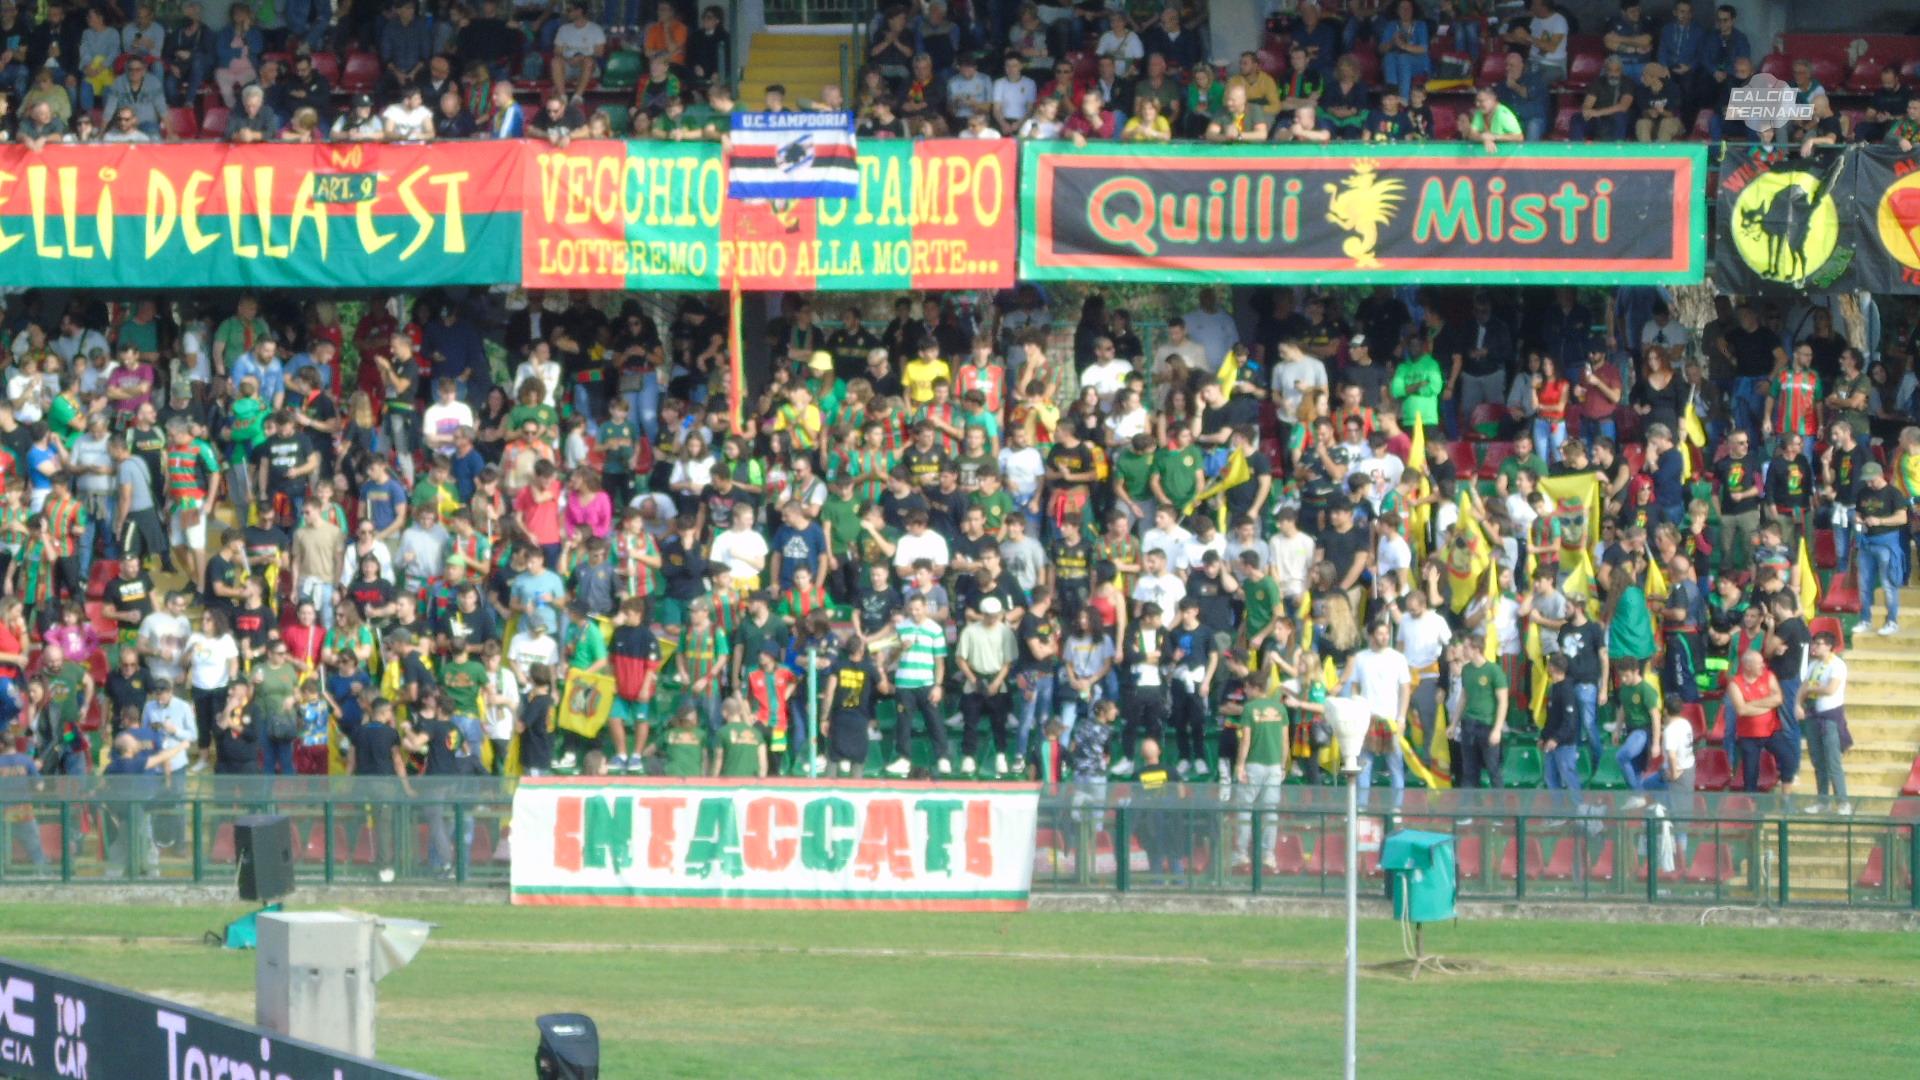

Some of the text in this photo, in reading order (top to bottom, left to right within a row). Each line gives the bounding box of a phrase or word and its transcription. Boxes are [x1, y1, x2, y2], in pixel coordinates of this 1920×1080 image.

[742, 113, 848, 128] U.C. SAMPDORIA
[145, 164, 328, 263] DELLA
[537, 154, 724, 226] VECCHIO
[1087, 174, 1613, 257] Quilli Misti
[538, 239, 999, 277] LOTTEREMO FINO ALLA MORTE...
[553, 796, 994, 879] INTACCATI
[54, 992, 87, 1037] TOP
[54, 1036, 88, 1080] CAR
